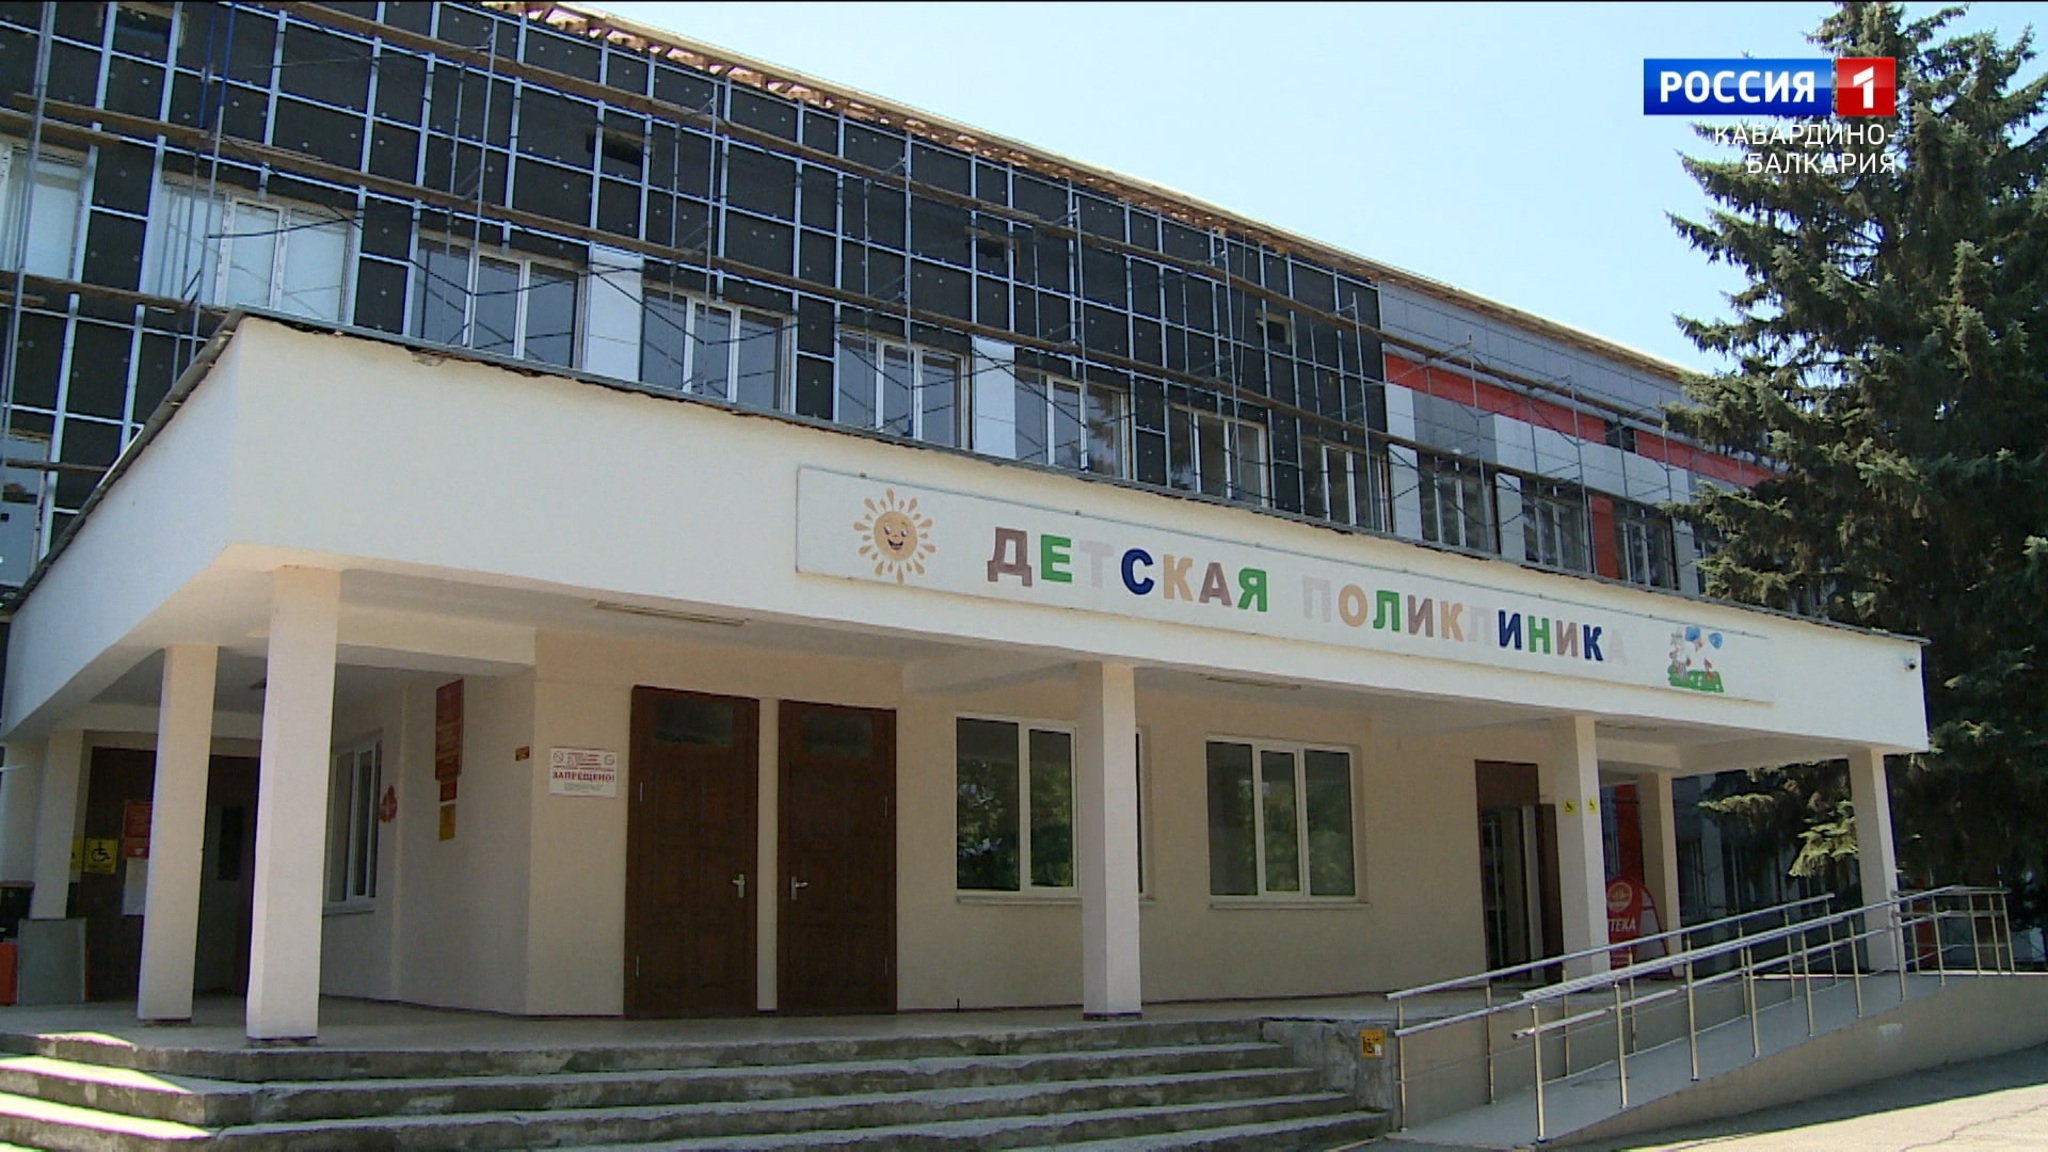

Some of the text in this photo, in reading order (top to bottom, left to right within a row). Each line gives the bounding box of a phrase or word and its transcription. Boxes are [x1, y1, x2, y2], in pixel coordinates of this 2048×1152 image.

[987, 526, 1628, 666] ДЕТСКАЯ ПОЛИКЛИНИКА
[553, 771, 615, 783] ЗАПРЕЩЕНО!
[1608, 918, 1636, 932] ТЕКА
